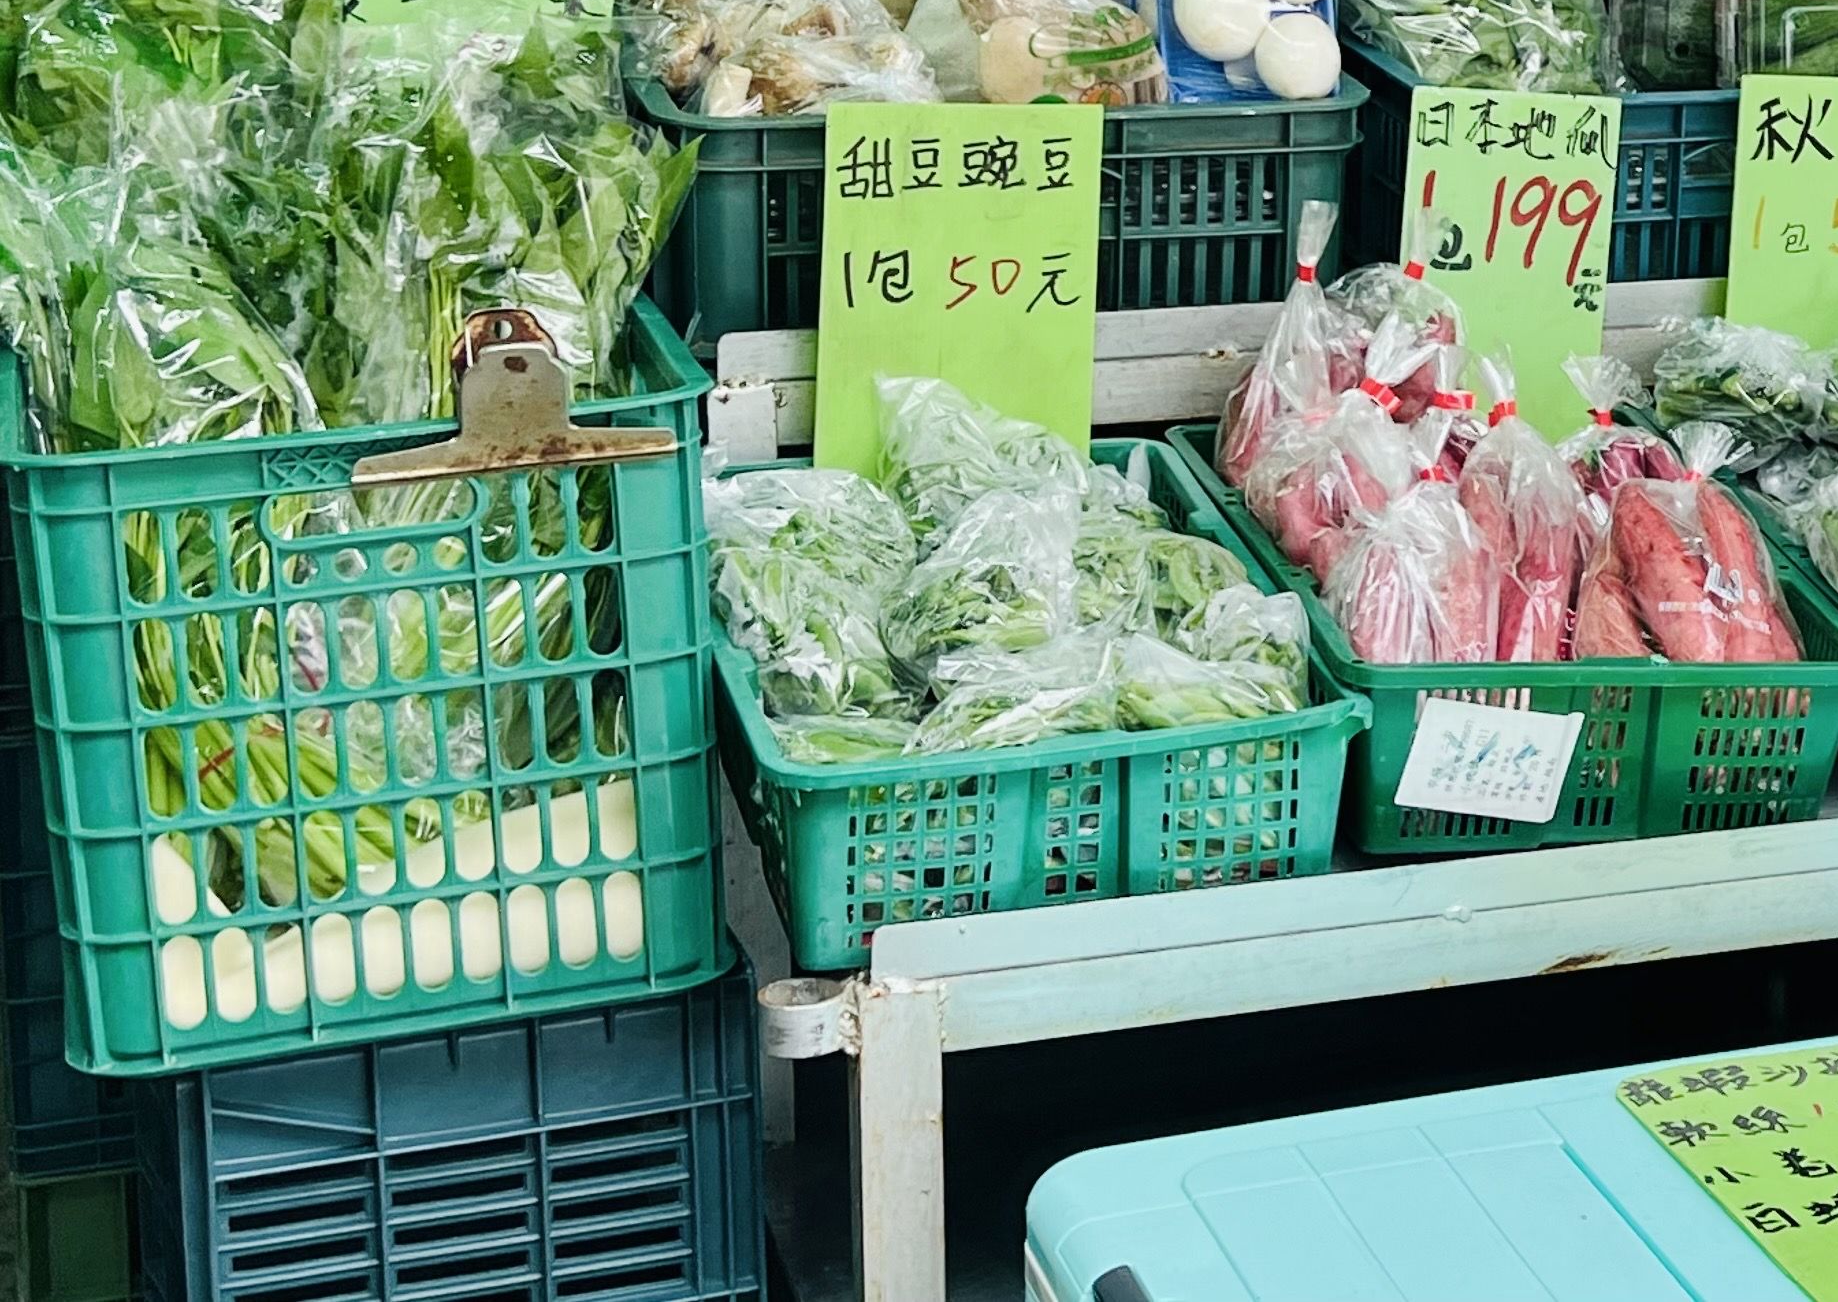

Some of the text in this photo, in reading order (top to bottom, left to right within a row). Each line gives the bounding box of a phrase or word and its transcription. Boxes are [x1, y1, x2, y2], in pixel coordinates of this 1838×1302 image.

[836, 135, 1074, 199] 甜豆豌豆
[1416, 98, 1617, 169] 日本地瓜
